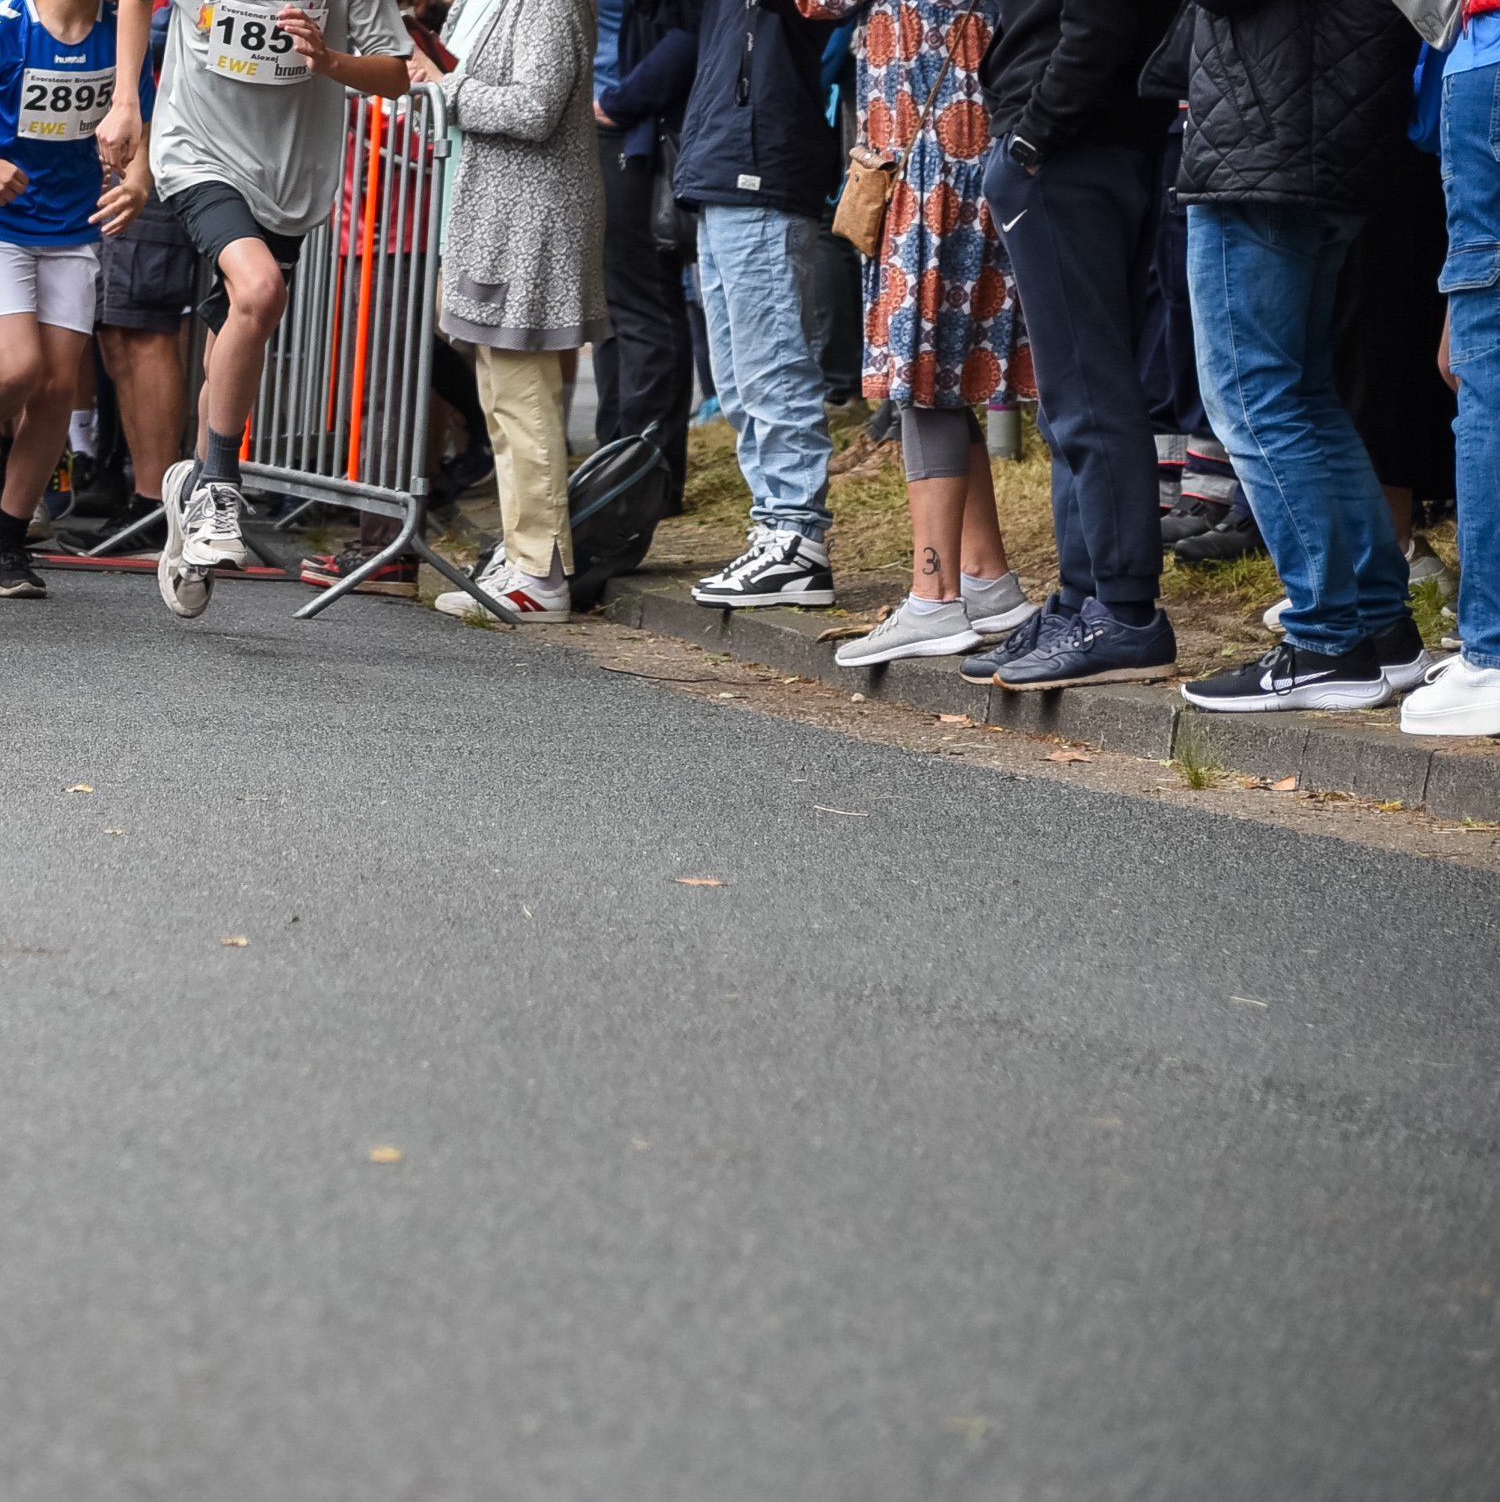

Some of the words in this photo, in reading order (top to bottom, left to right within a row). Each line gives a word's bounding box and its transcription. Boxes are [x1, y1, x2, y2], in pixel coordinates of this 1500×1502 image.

[221, 5, 267, 19] Everstener
[217, 16, 294, 54] 185
[251, 53, 279, 63] Alexej
[217, 55, 259, 76] EWE
[274, 63, 307, 76] bruns
[31, 75, 72, 84] Everstener
[24, 80, 114, 112] 2895
[29, 121, 67, 135] EWE
